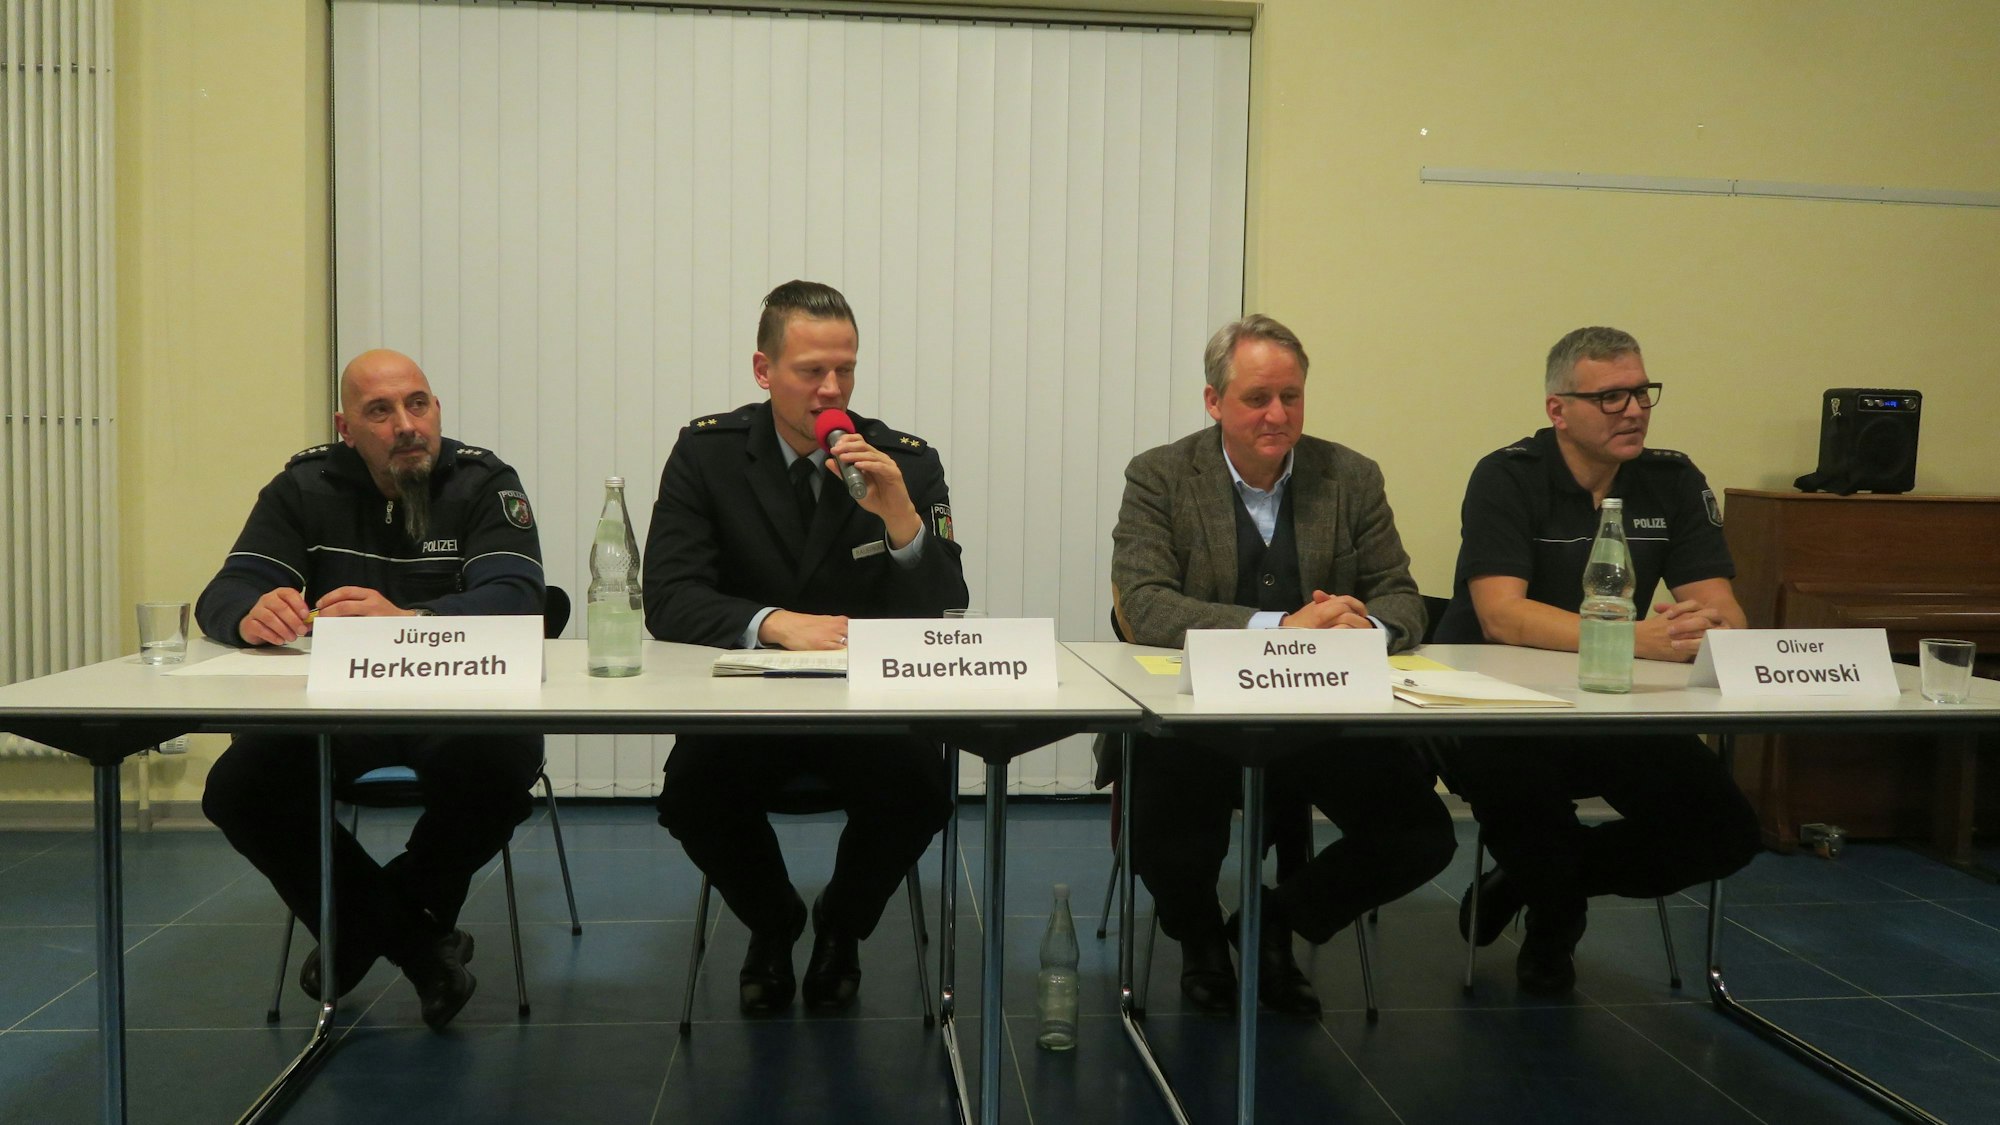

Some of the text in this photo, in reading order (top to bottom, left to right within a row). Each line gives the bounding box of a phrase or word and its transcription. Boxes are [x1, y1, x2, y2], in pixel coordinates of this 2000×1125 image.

[422, 539, 458, 553] POLIZEI
[393, 627, 466, 648] Jürgen
[923, 629, 983, 646] Stefan
[1263, 640, 1317, 656] Andre
[1776, 639, 1825, 654] Oliver
[348, 654, 507, 679] Herkenrath
[882, 657, 1029, 681] Bauerkamp
[1754, 663, 1861, 685] Borowski
[1238, 668, 1350, 690] Schirmer
